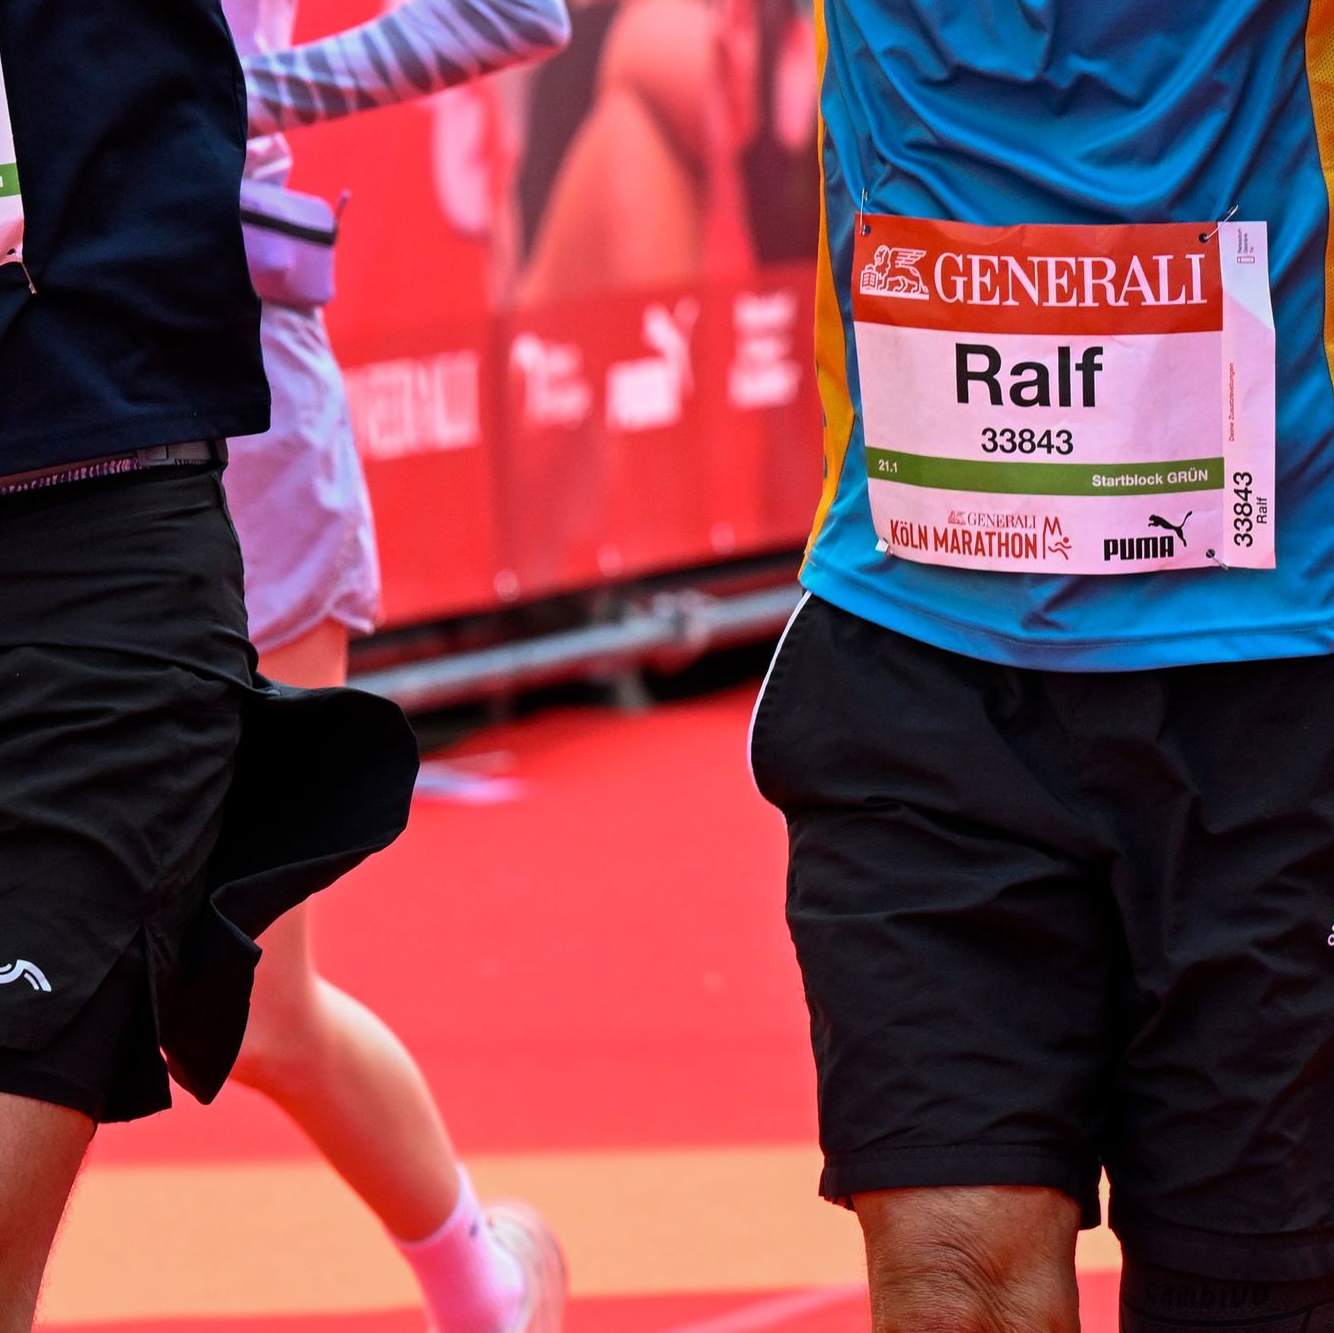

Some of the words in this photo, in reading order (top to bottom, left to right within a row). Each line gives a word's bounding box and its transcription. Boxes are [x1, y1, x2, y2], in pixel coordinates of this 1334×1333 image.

[934, 253, 1208, 307] GENERALI
[955, 343, 1104, 408] Ralf
[981, 428, 1074, 455] 33843
[878, 459, 898, 474] 21.1
[1092, 473, 1163, 487] Startblock
[1167, 468, 1209, 484] GRÜN
[967, 512, 1036, 528] GENERALI
[1233, 471, 1254, 548] 33843
[1256, 496, 1268, 524] Ralf
[890, 518, 929, 548] KÖLN
[933, 530, 1038, 560] MARATHON
[1104, 535, 1175, 561] PUMA
